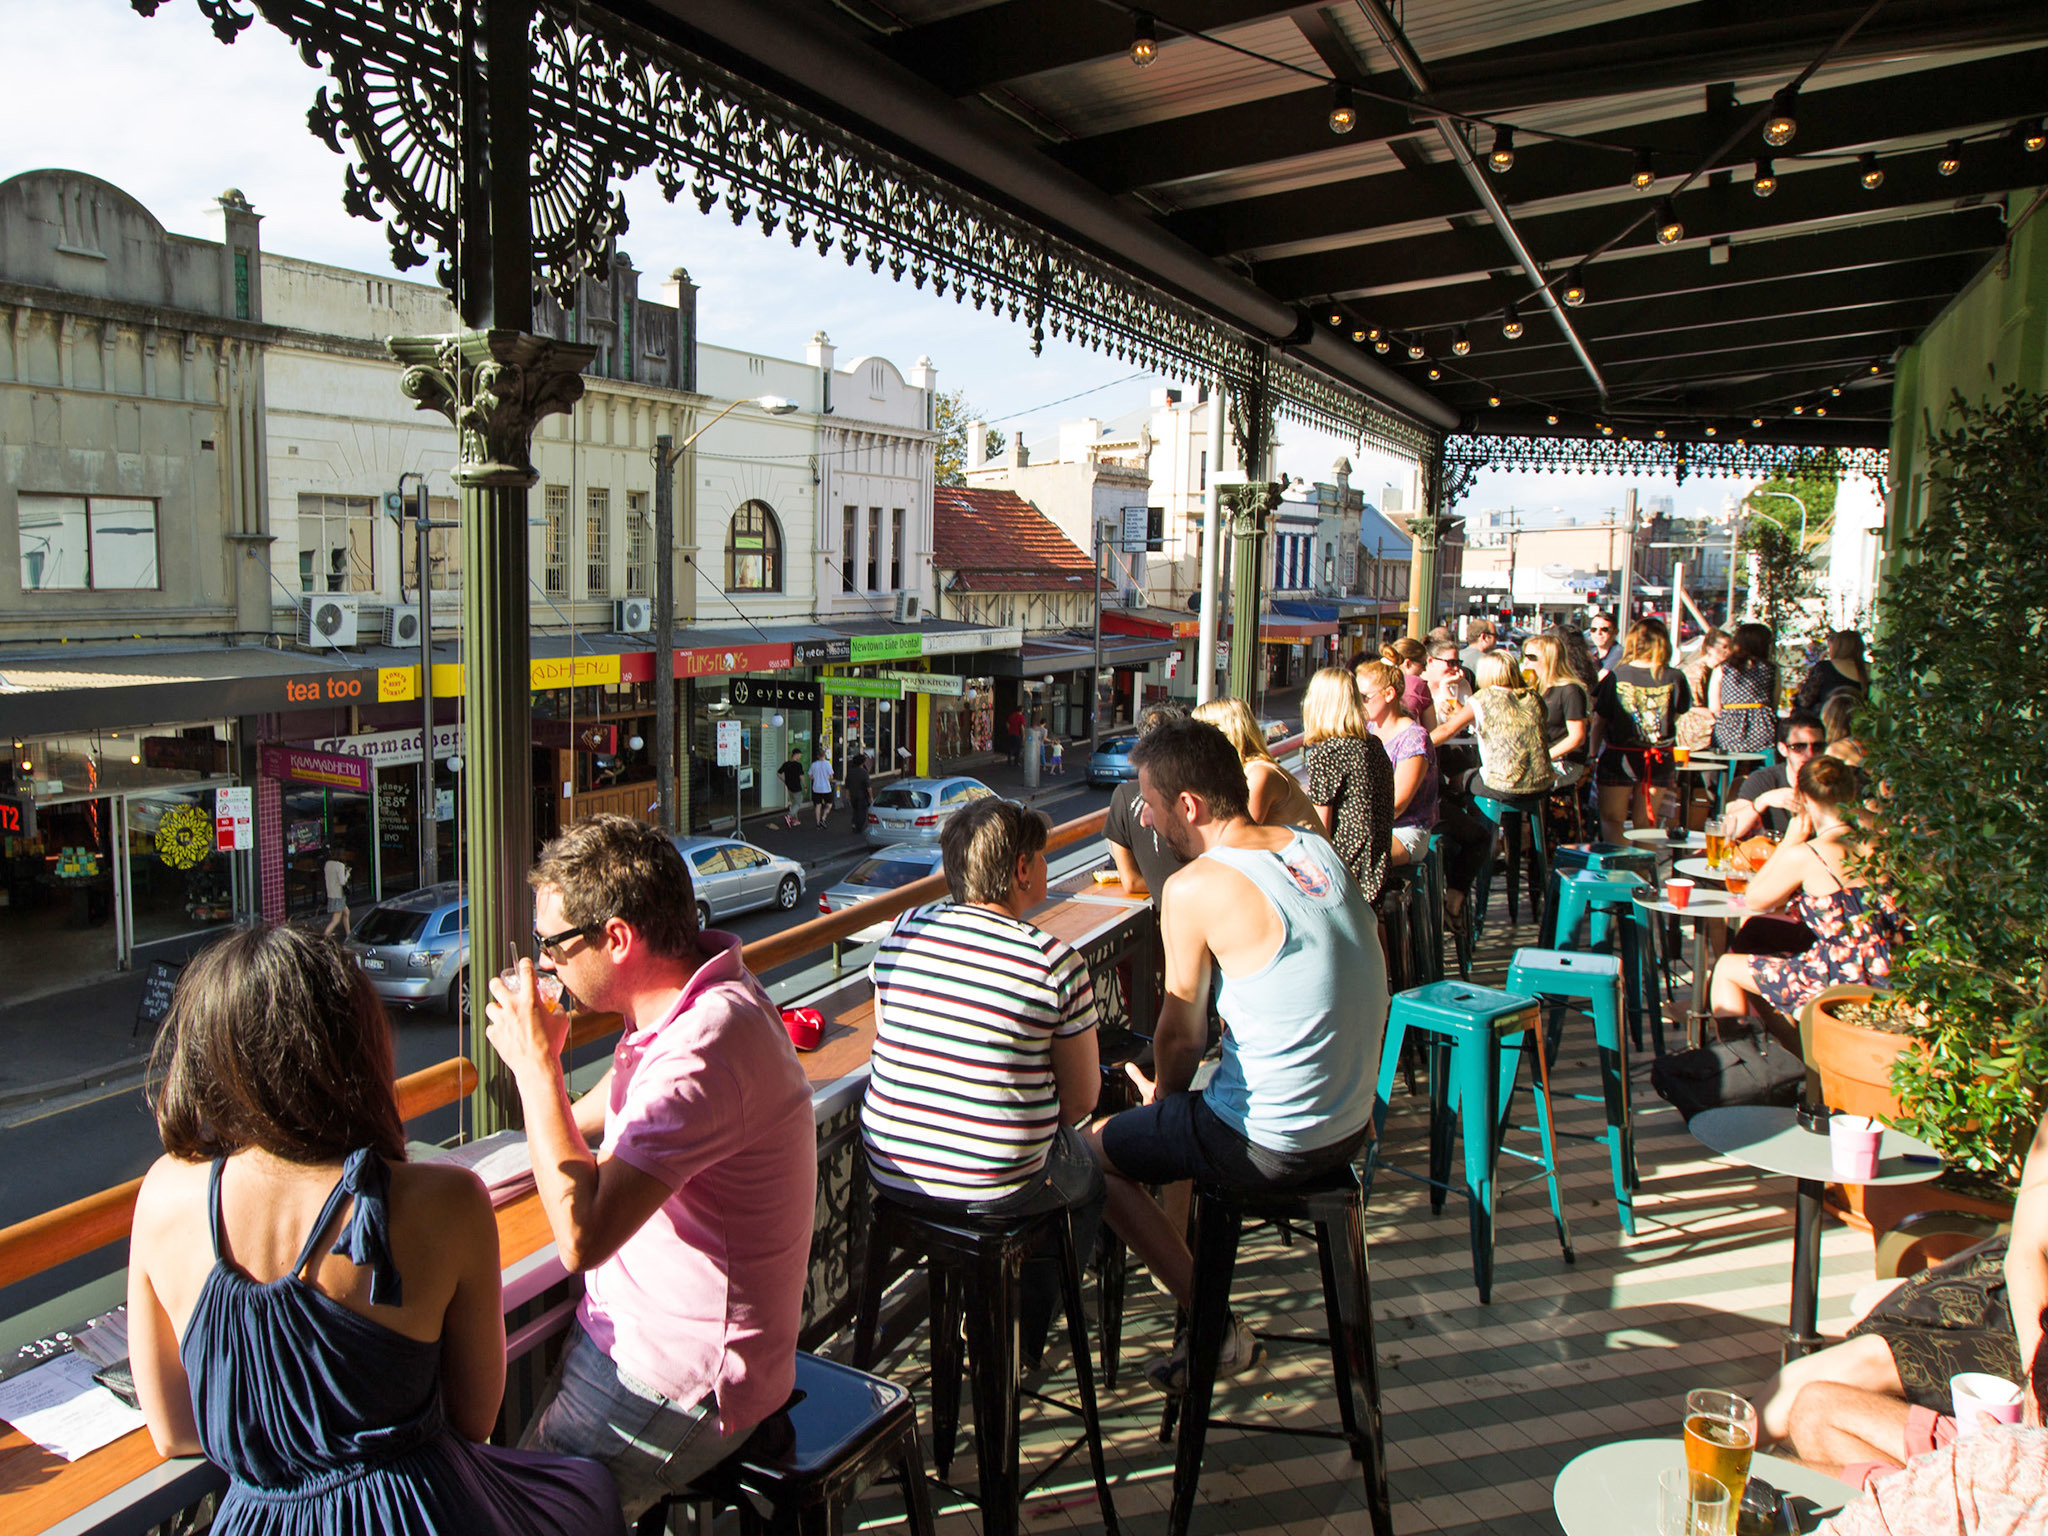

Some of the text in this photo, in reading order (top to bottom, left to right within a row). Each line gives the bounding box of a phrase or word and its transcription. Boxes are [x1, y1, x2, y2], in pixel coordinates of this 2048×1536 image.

[852, 641, 883, 653] Newtown
[884, 639, 899, 650] Elite
[900, 636, 920, 649] Dental
[622, 672, 632, 682] 169
[286, 677, 362, 702] tea too
[290, 754, 360, 777] KAMMADHENU
[0, 804, 20, 832] T2
[178, 831, 190, 842] T2
